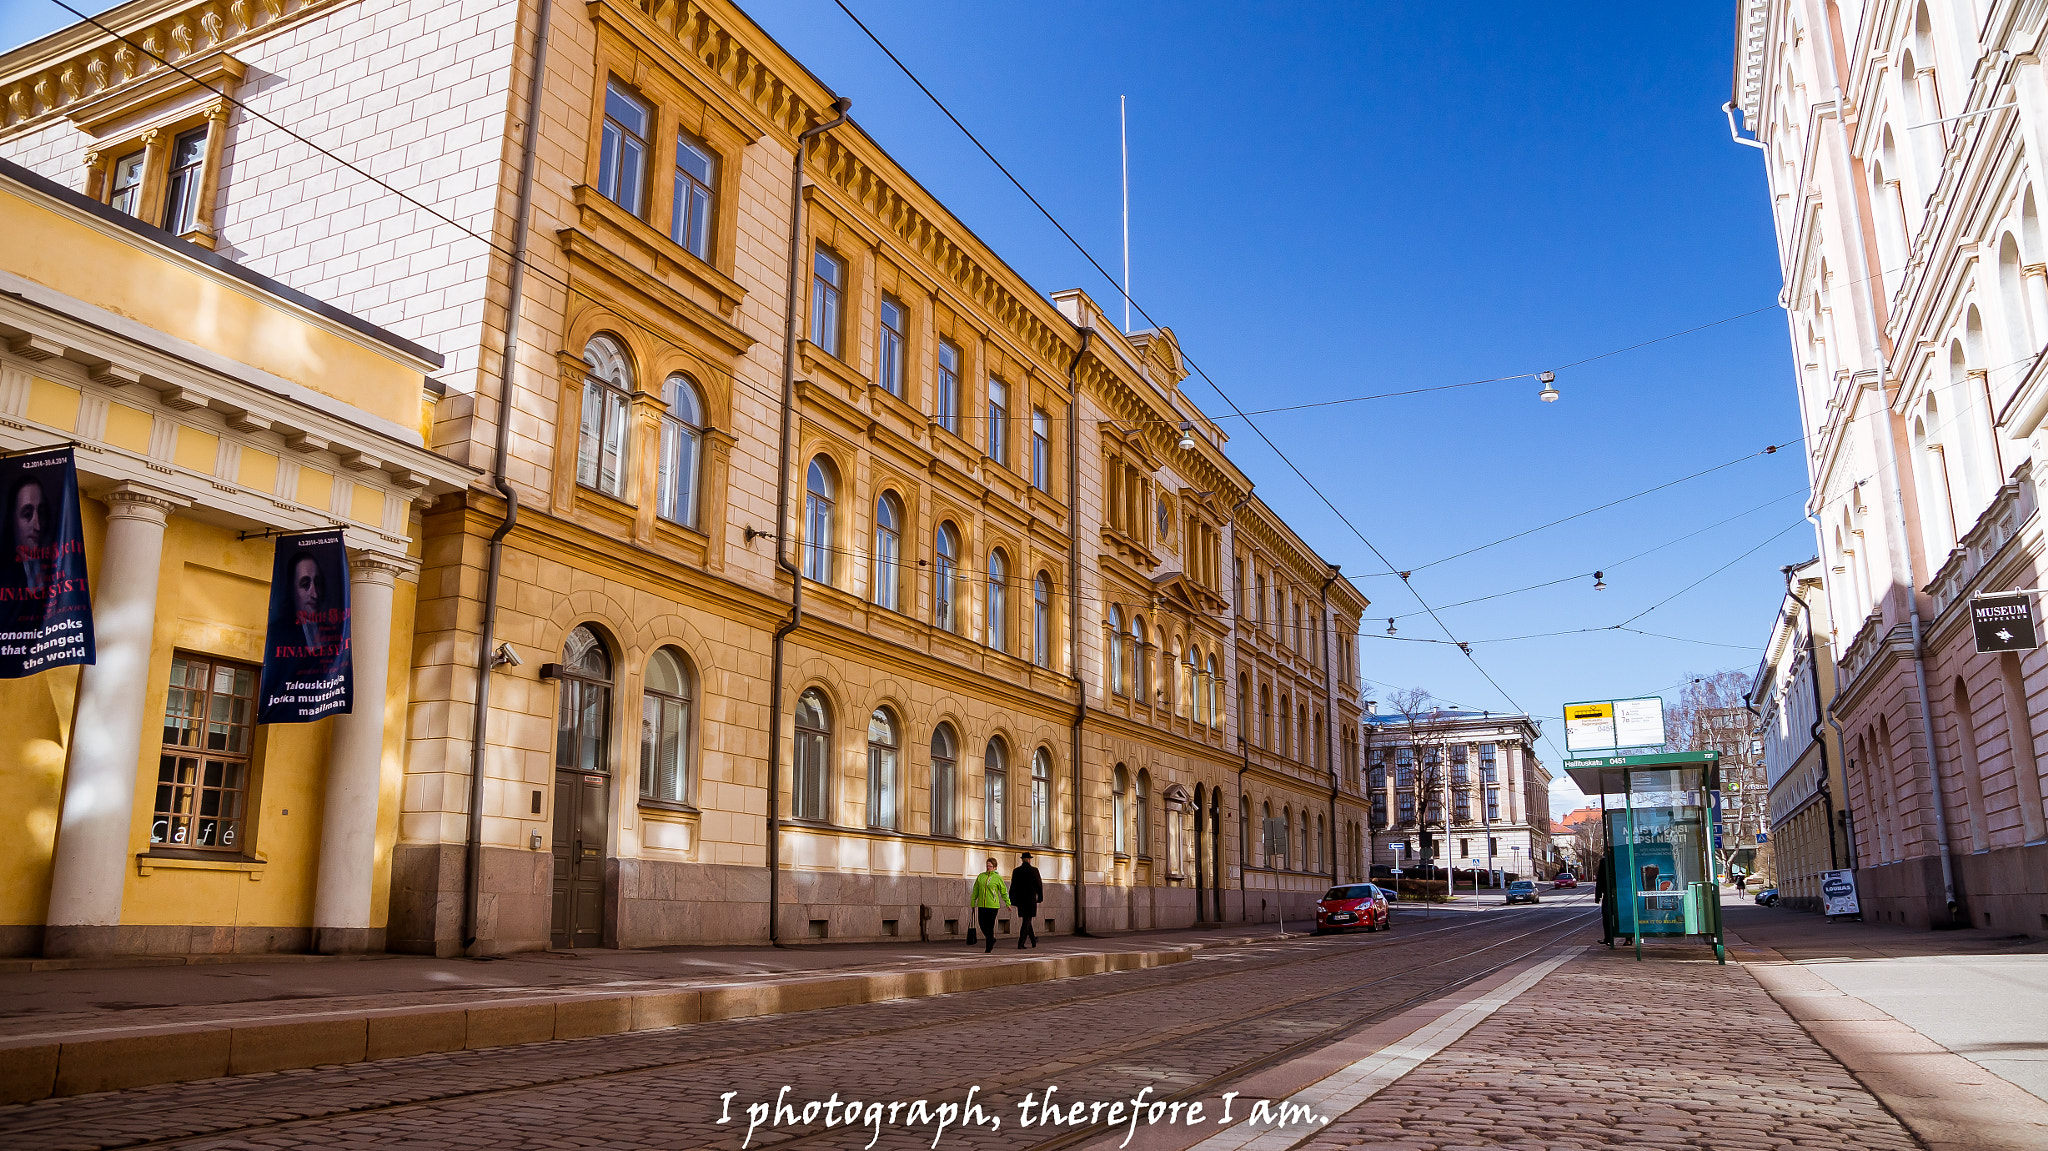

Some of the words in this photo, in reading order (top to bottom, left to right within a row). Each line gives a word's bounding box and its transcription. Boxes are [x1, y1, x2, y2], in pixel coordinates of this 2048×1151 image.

[1975, 604, 2028, 618] MUSEUM
[0, 628, 44, 641] onomic
[45, 618, 83, 636] books
[1, 645, 27, 656] that
[29, 633, 84, 655] changed
[23, 658, 44, 670] the
[46, 646, 86, 662] world
[297, 685, 346, 703] muuttivat
[298, 699, 346, 716] maailman
[1609, 757, 1627, 765] 0451
[151, 820, 235, 845] Café
